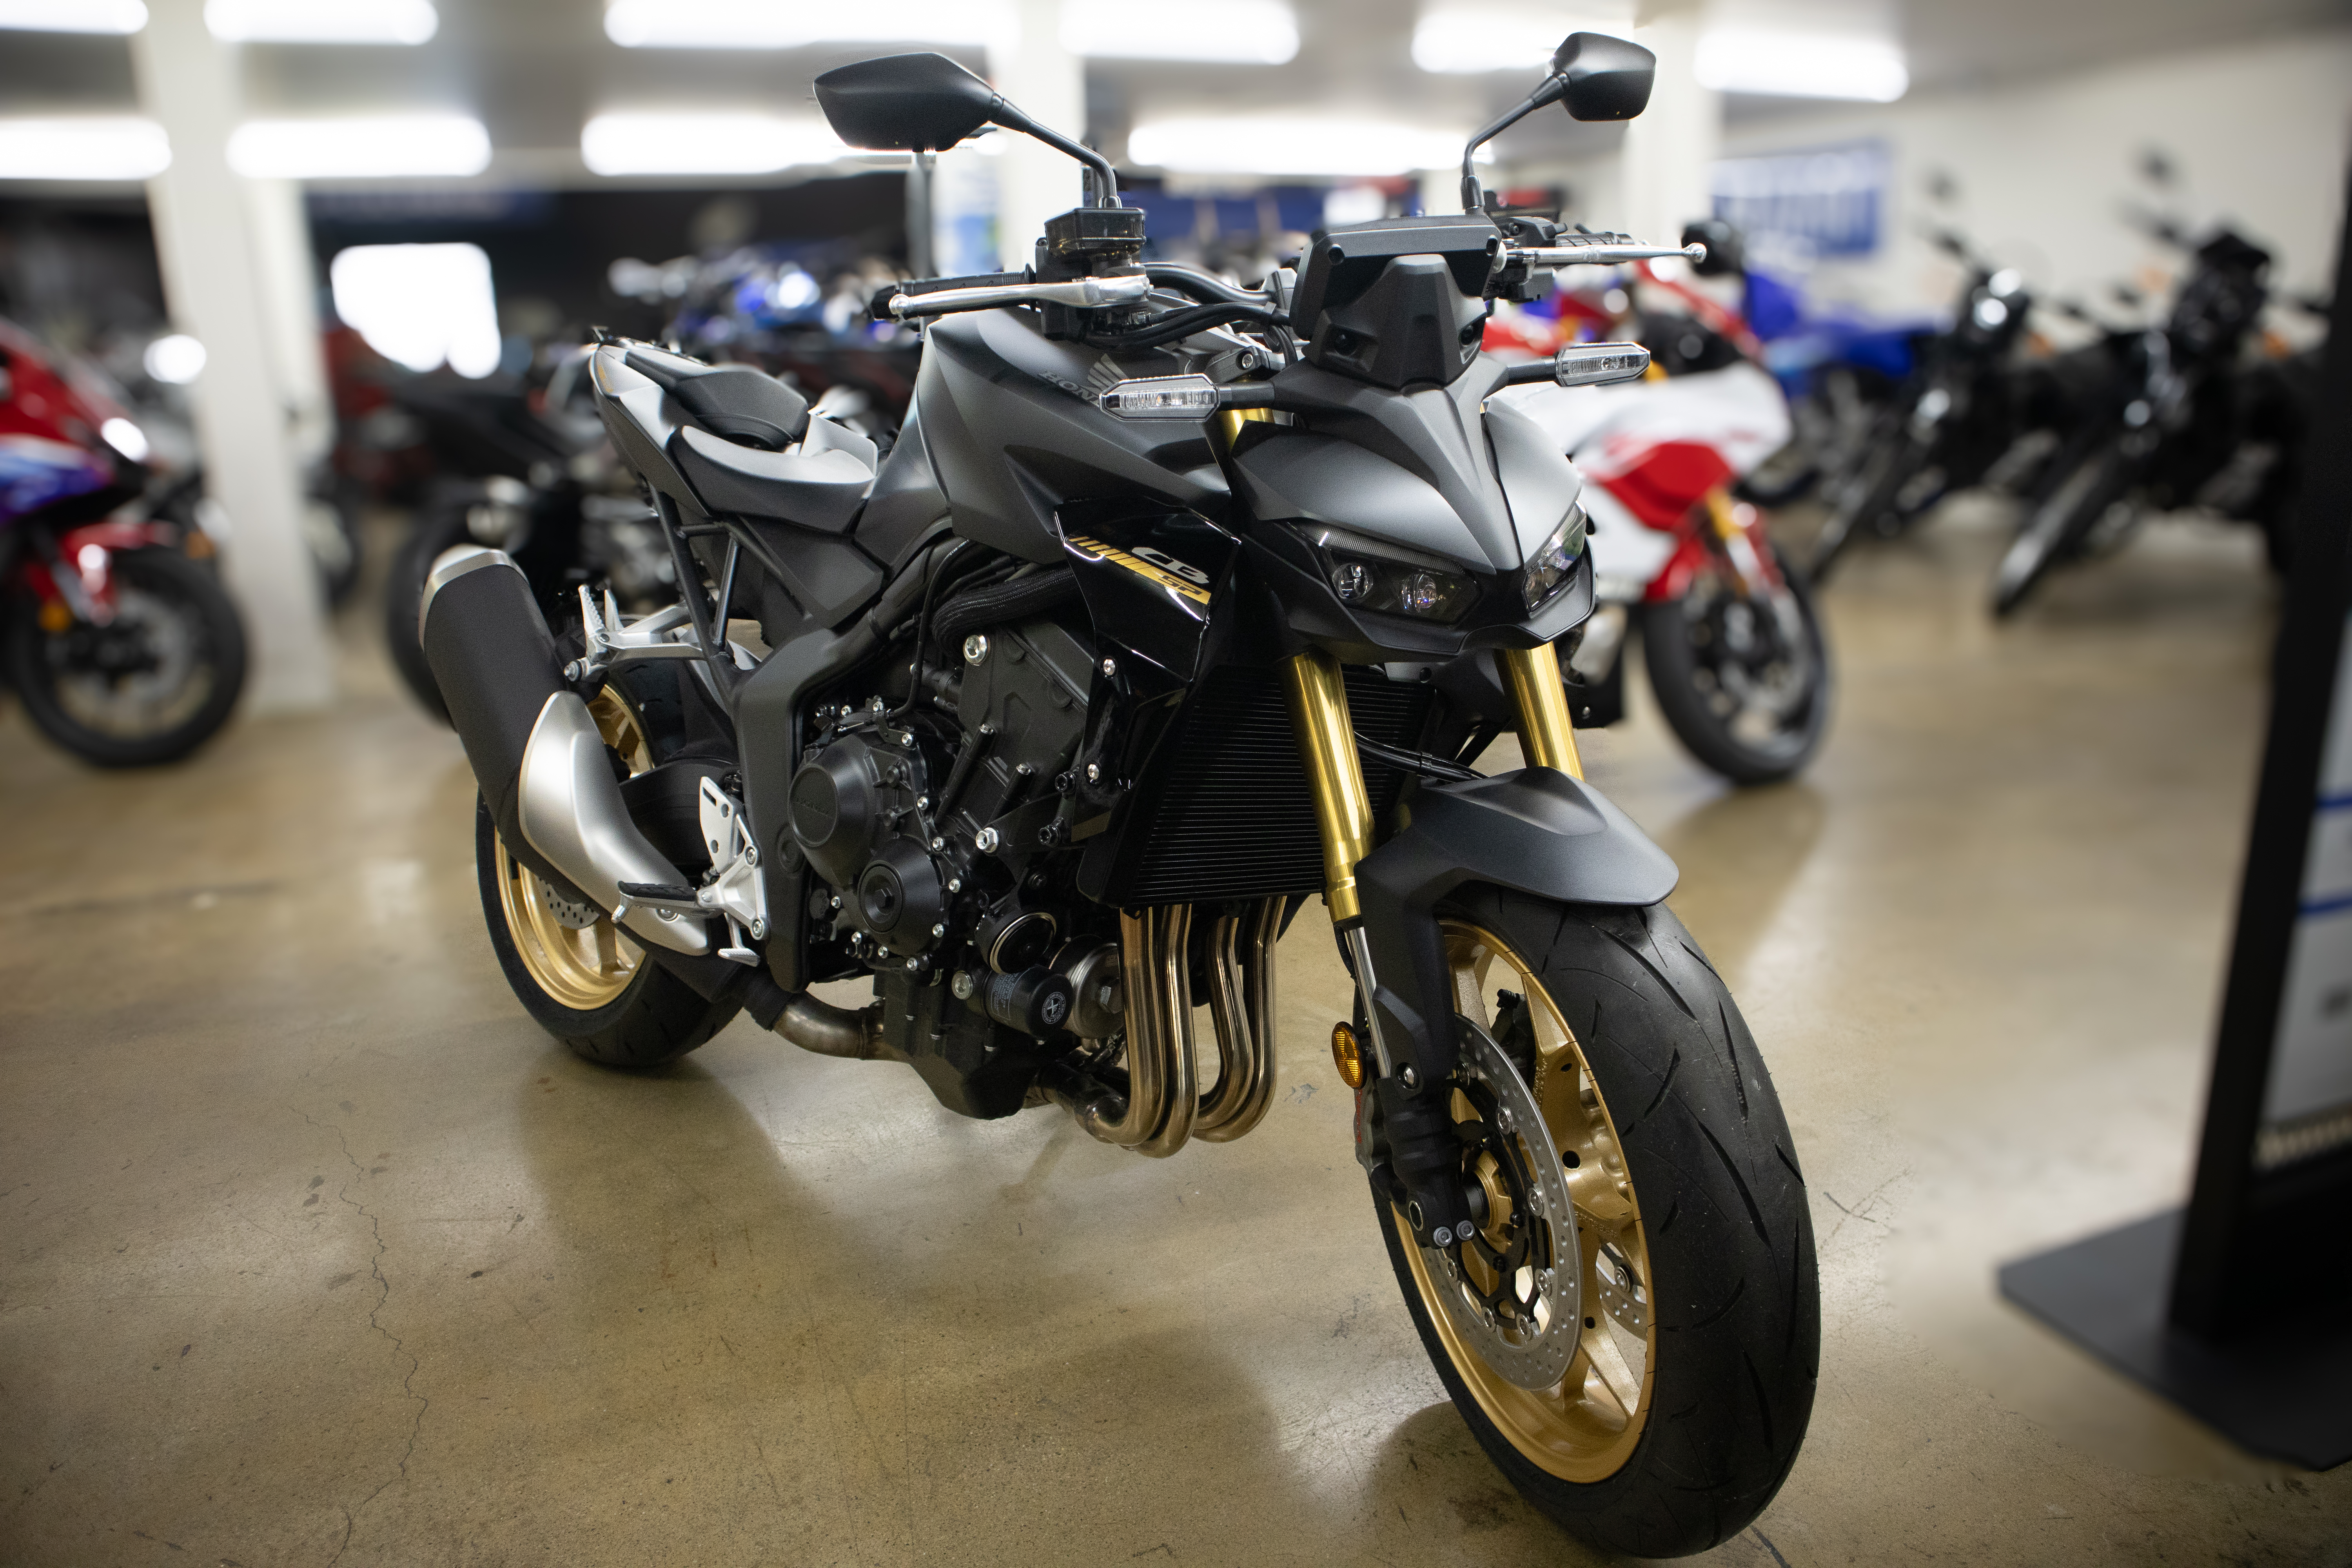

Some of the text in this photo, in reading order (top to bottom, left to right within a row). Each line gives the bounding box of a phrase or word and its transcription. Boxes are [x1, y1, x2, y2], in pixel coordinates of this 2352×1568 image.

[1038, 371, 1100, 408] HON
[1131, 546, 1210, 584] CB
[1158, 574, 1202, 595] SP
